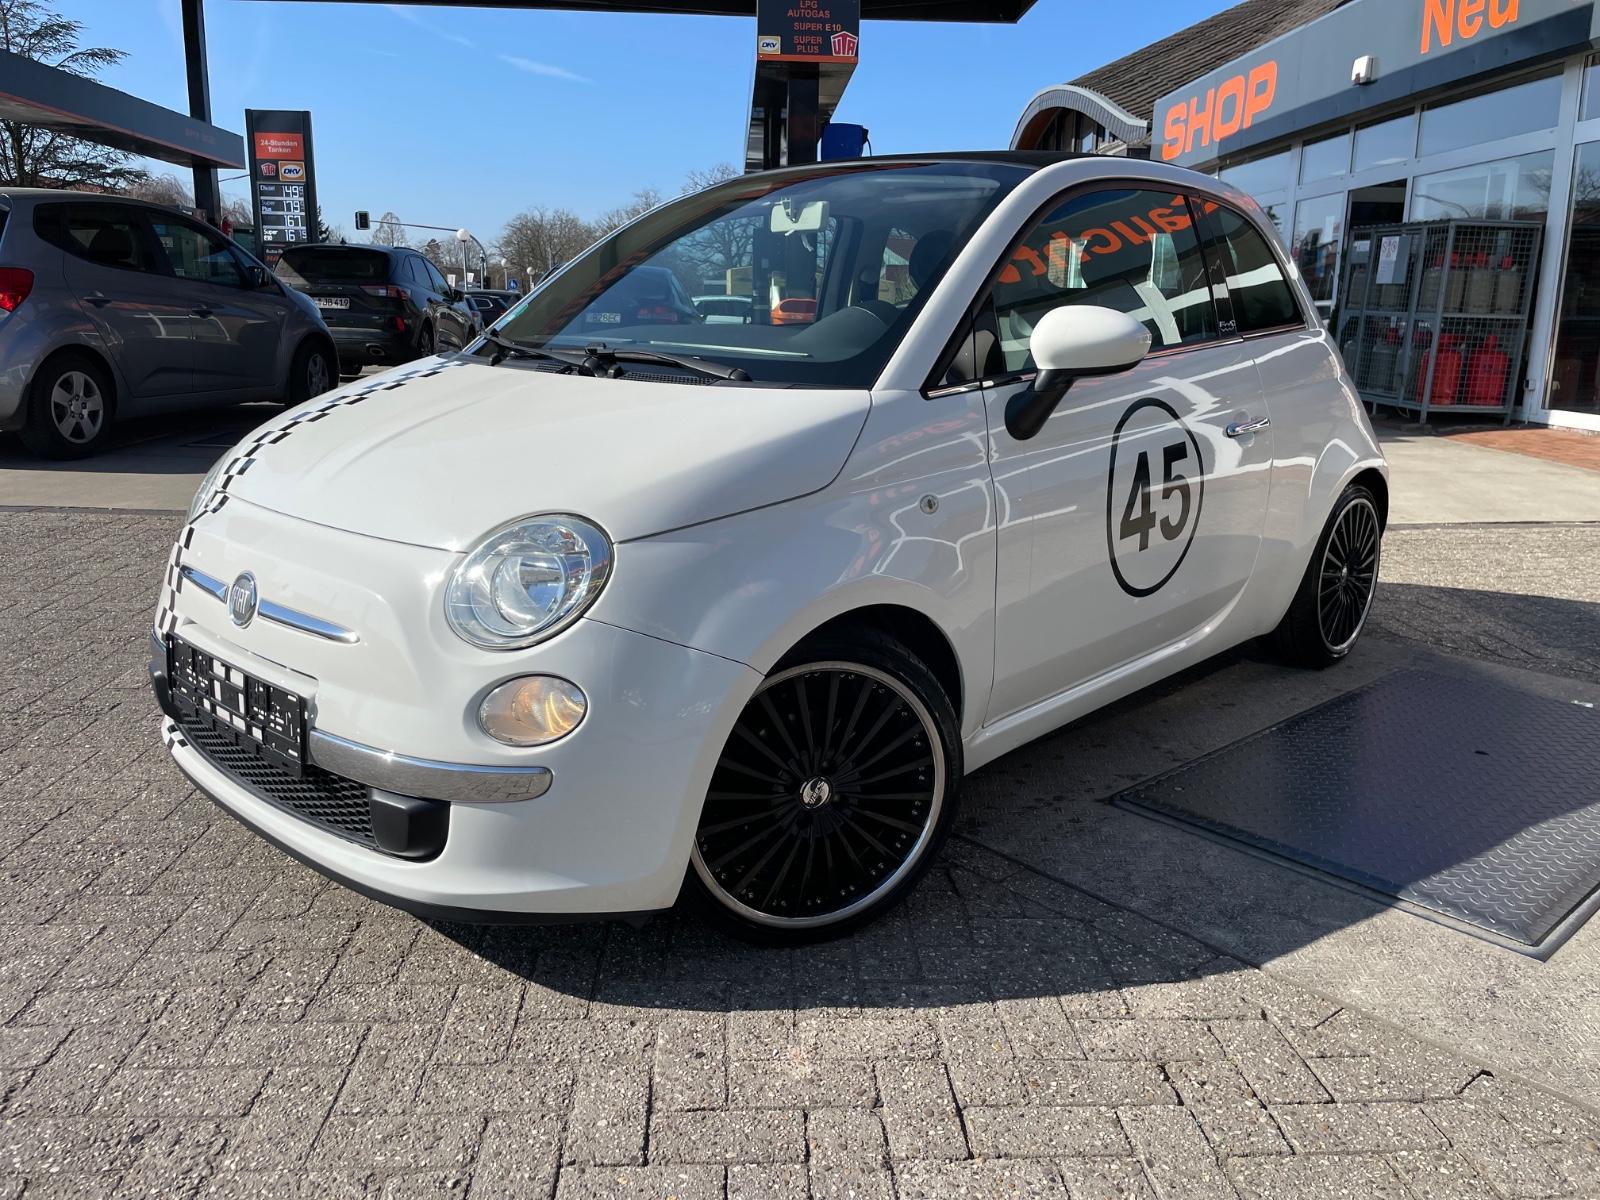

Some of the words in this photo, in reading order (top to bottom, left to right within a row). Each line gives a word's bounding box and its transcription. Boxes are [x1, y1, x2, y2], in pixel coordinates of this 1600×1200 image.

[800, 0, 818, 9] LPG
[787, 9, 831, 19] AUTOGAS
[793, 22, 823, 31] SUPER
[1420, 0, 1520, 55] Neu
[793, 36, 823, 45] SUPER
[831, 32, 858, 56] UTA
[796, 45, 820, 53] PLUS
[1161, 59, 1278, 161] SHOP
[260, 139, 298, 147] 24-Stunden
[283, 167, 301, 175] DKV
[1119, 440, 1191, 553] 45
